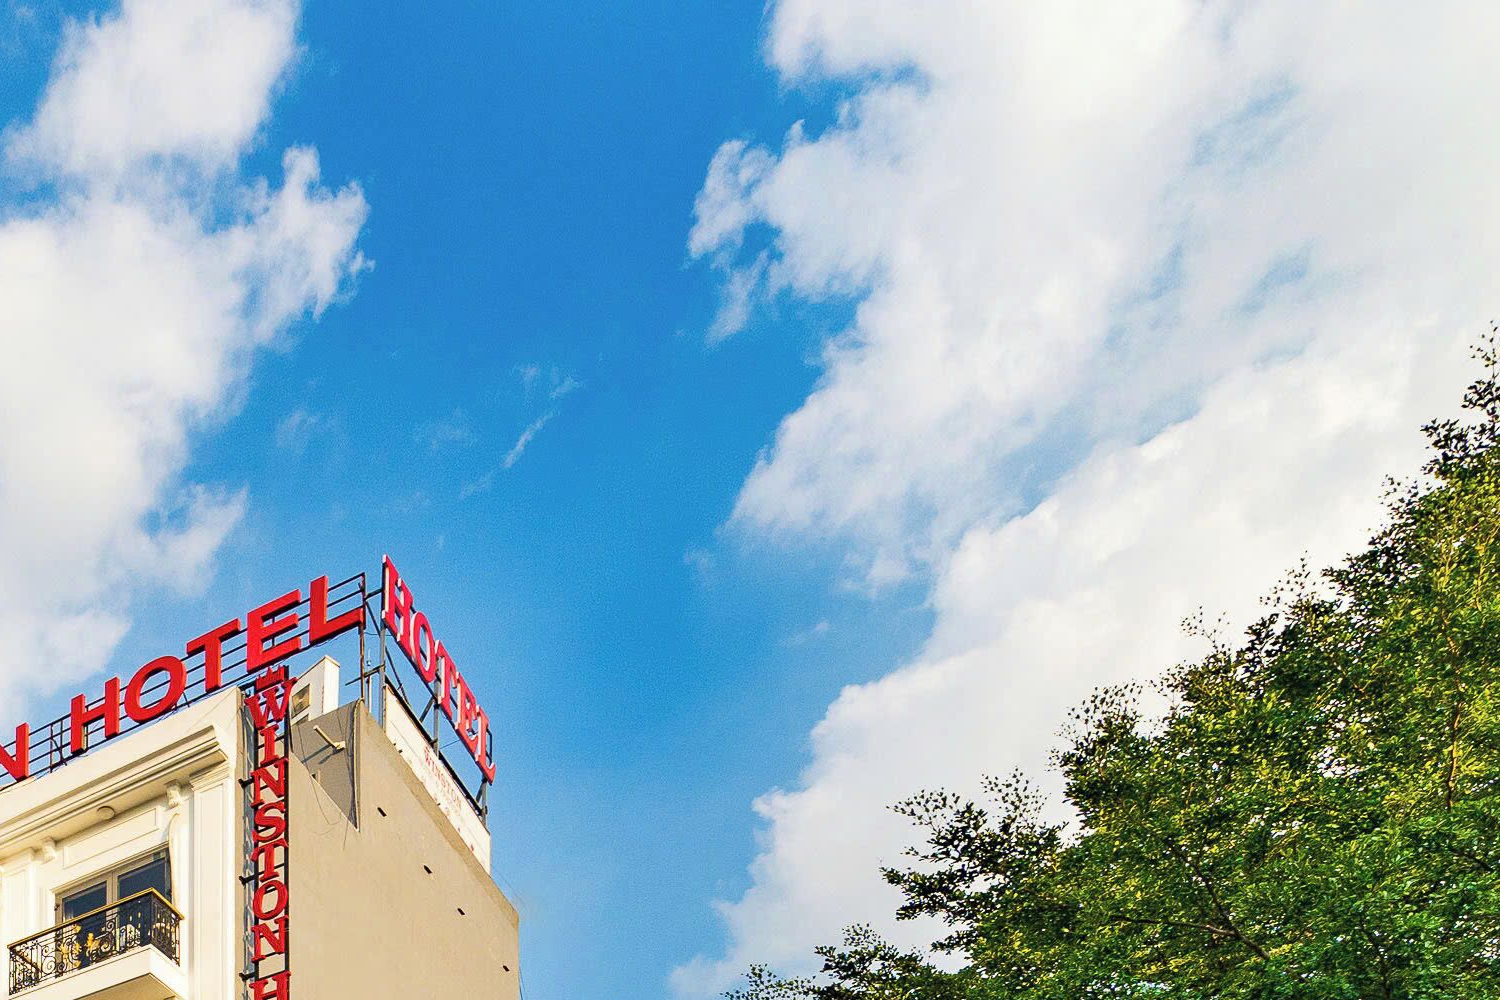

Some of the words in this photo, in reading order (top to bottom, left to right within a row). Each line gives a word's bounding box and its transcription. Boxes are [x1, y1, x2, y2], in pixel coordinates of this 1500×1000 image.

[69, 575, 366, 754] HOTEL
[382, 554, 496, 784] HOTEL
[244, 677, 298, 963] WINSTON
